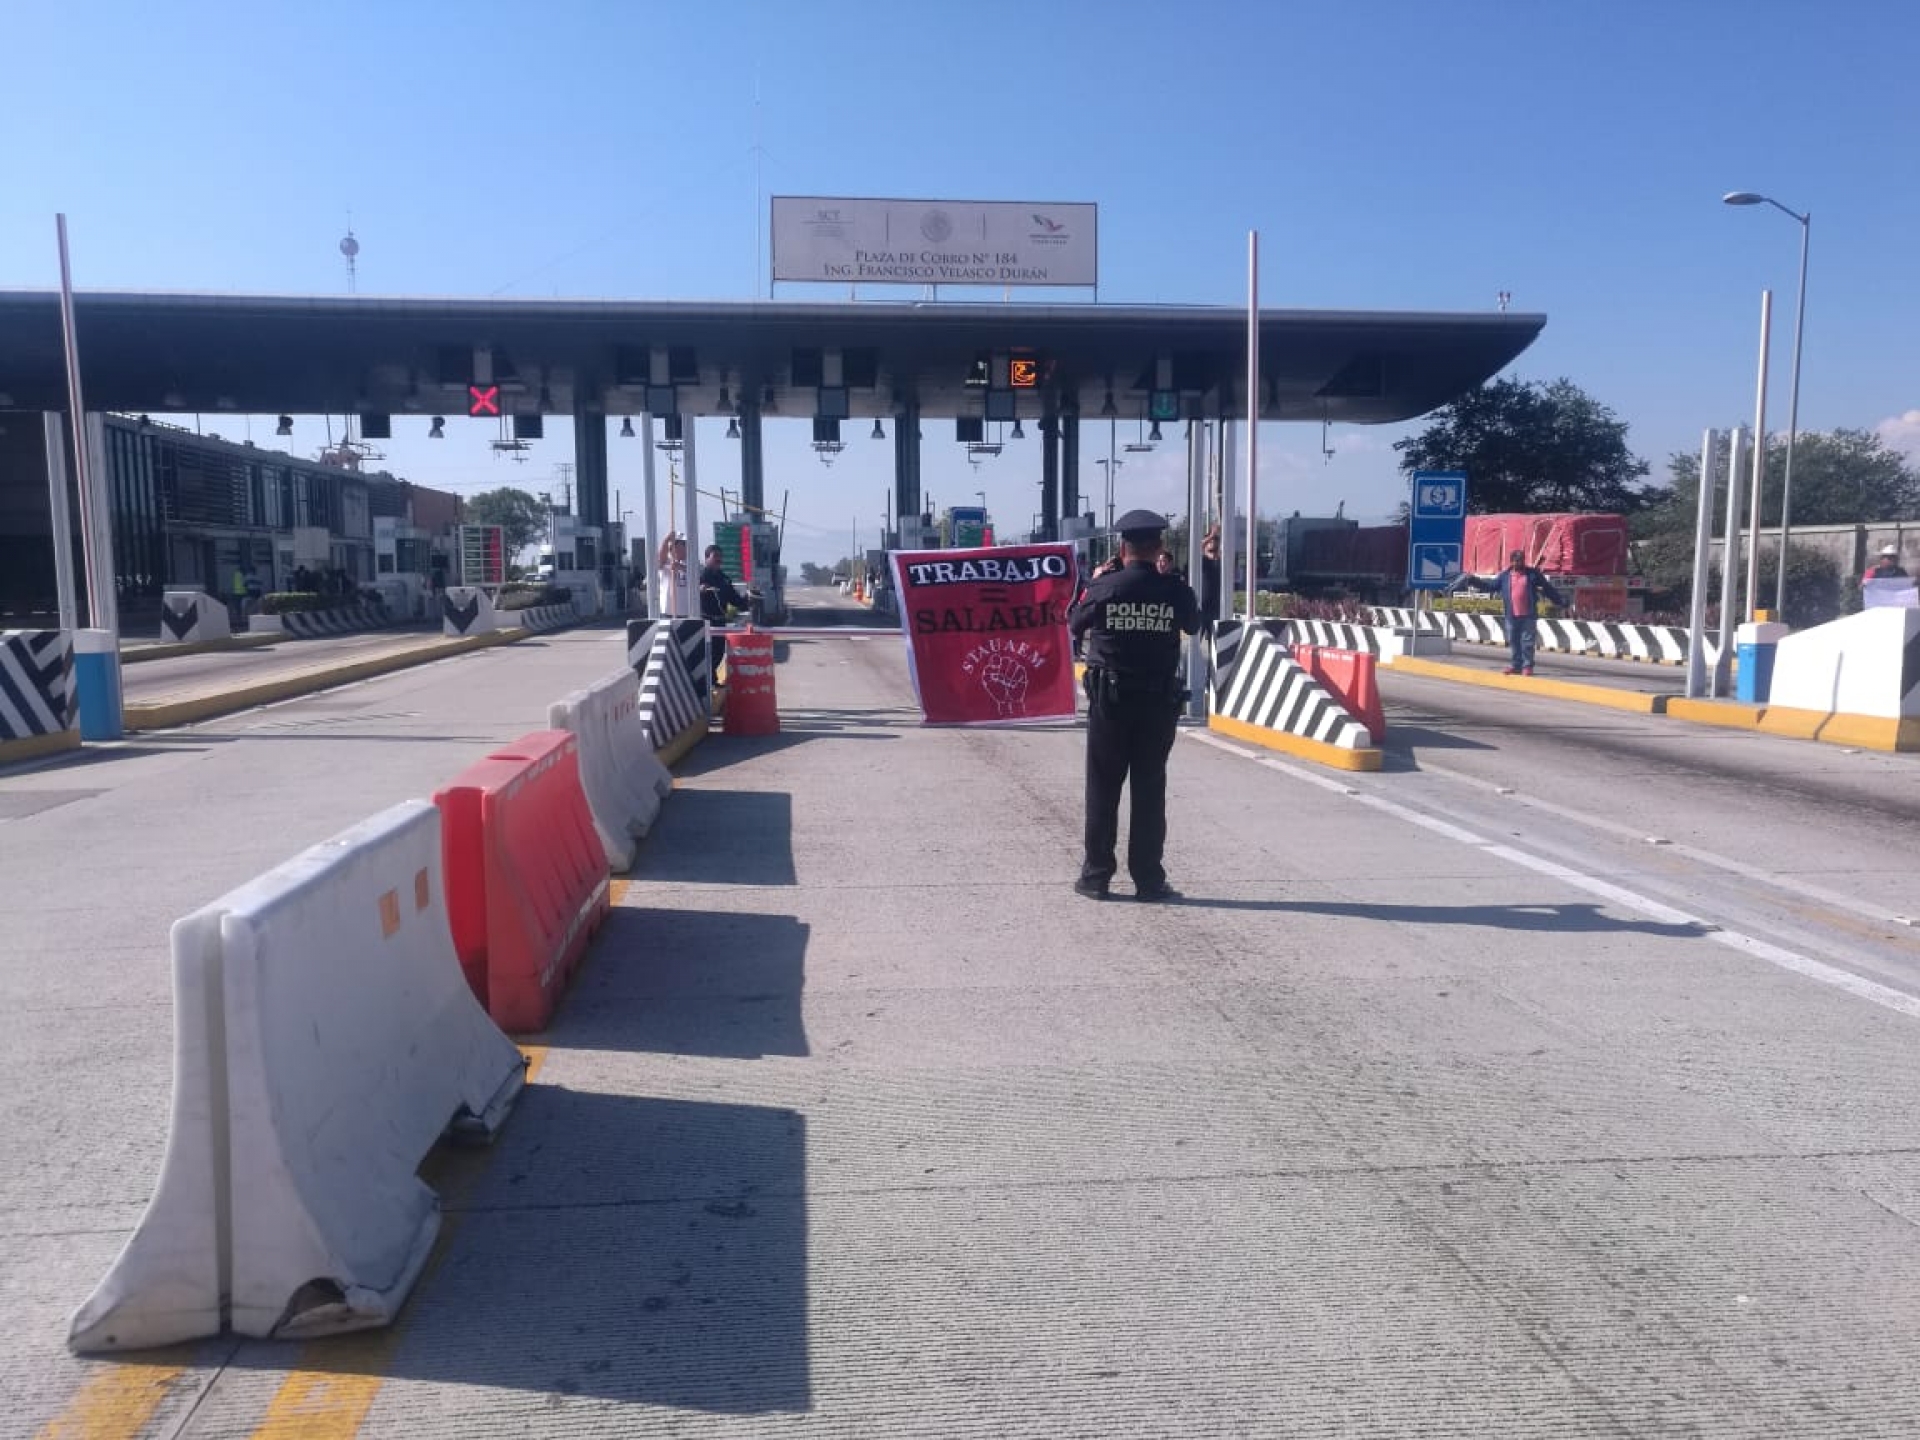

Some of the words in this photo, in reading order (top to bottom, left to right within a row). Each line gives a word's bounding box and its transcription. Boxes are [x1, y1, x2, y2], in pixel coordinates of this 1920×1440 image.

[855, 249, 894, 263] PLAZA
[920, 250, 970, 265] COBRO
[995, 252, 1018, 265] 184
[857, 263, 934, 277] FRANCISCO
[939, 265, 996, 278] VELASCO
[999, 266, 1048, 280] DURÁN
[909, 555, 1067, 585] TRABAJO
[1106, 602, 1174, 619] POLICÍA
[1106, 616, 1173, 632] FEDERAL
[962, 638, 1046, 672] STAUAEM
